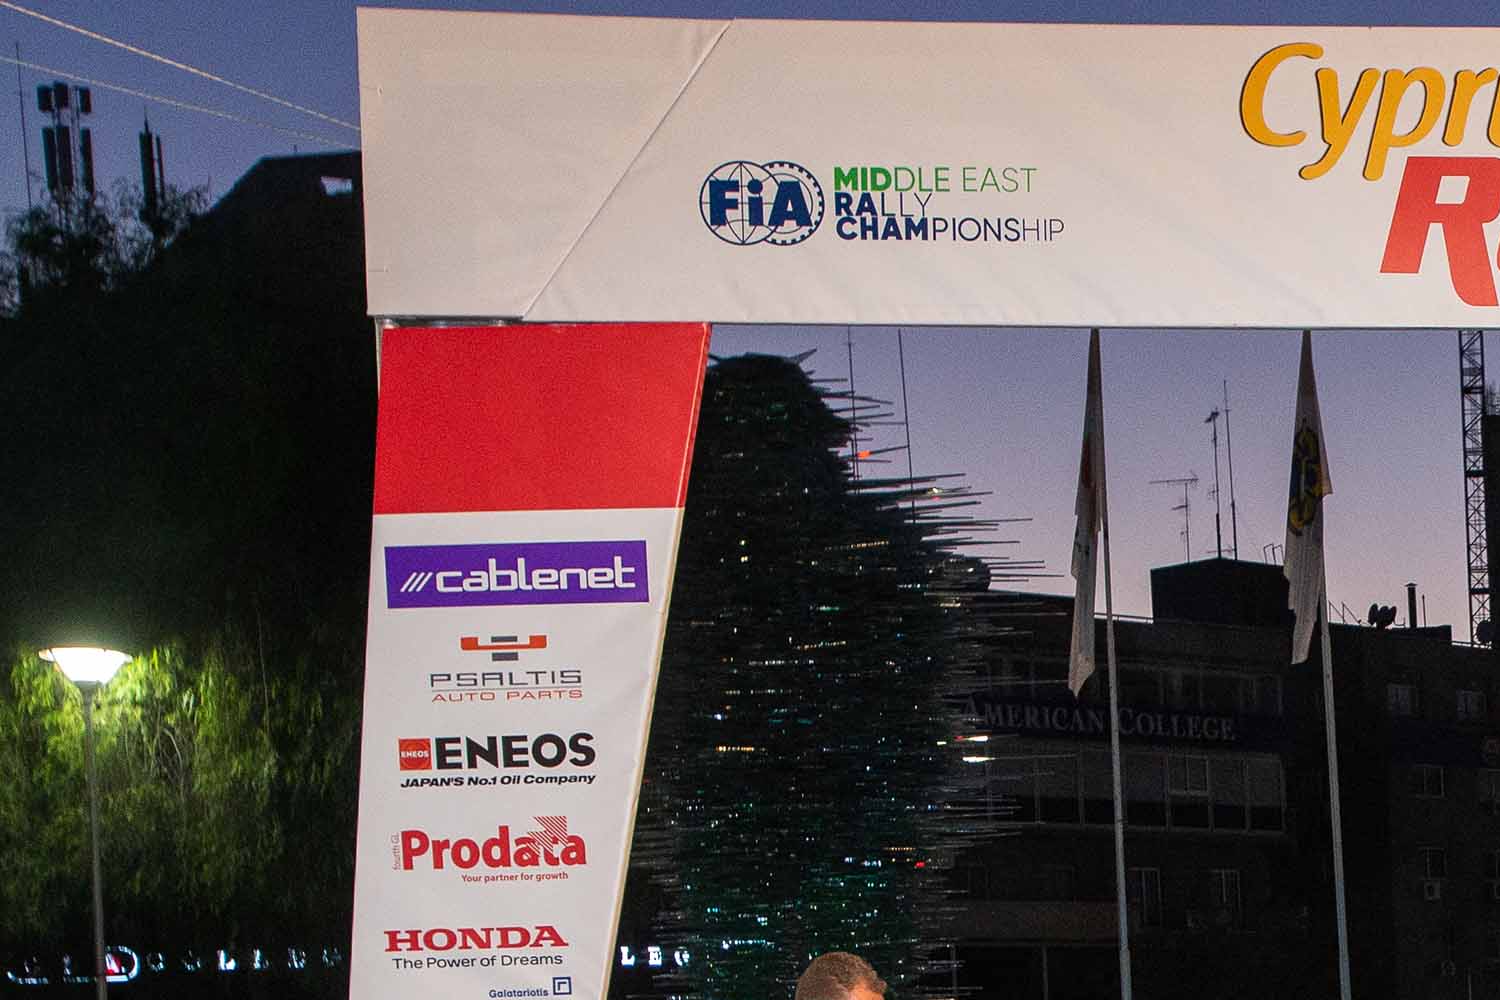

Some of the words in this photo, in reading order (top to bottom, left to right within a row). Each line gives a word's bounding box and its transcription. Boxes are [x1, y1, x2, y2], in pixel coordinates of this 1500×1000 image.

[833, 167, 951, 193] MIDDLE
[962, 167, 1037, 193] EAST
[835, 192, 932, 218] RALLY
[836, 217, 1064, 241] CHAMPIONSHIP
[435, 556, 636, 593] cablenet
[430, 670, 582, 688] PSALTIS
[432, 692, 495, 703] AUTO
[506, 690, 583, 701] PARTS
[435, 733, 596, 770] ENEOS
[400, 777, 464, 788] JAPAN'S
[467, 776, 497, 786] No.1
[500, 775, 520, 785] Oil
[523, 774, 596, 785] Company
[401, 825, 587, 870] Prodata
[461, 874, 481, 883] Your
[484, 874, 519, 884] partner
[521, 872, 534, 881] for
[535, 871, 568, 882] growth
[384, 926, 569, 953] HONDA
[392, 957, 423, 969] The
[427, 957, 476, 969] Power
[480, 955, 497, 968] of
[501, 954, 563, 967] Dreams
[489, 988, 549, 999] Galatariotis
